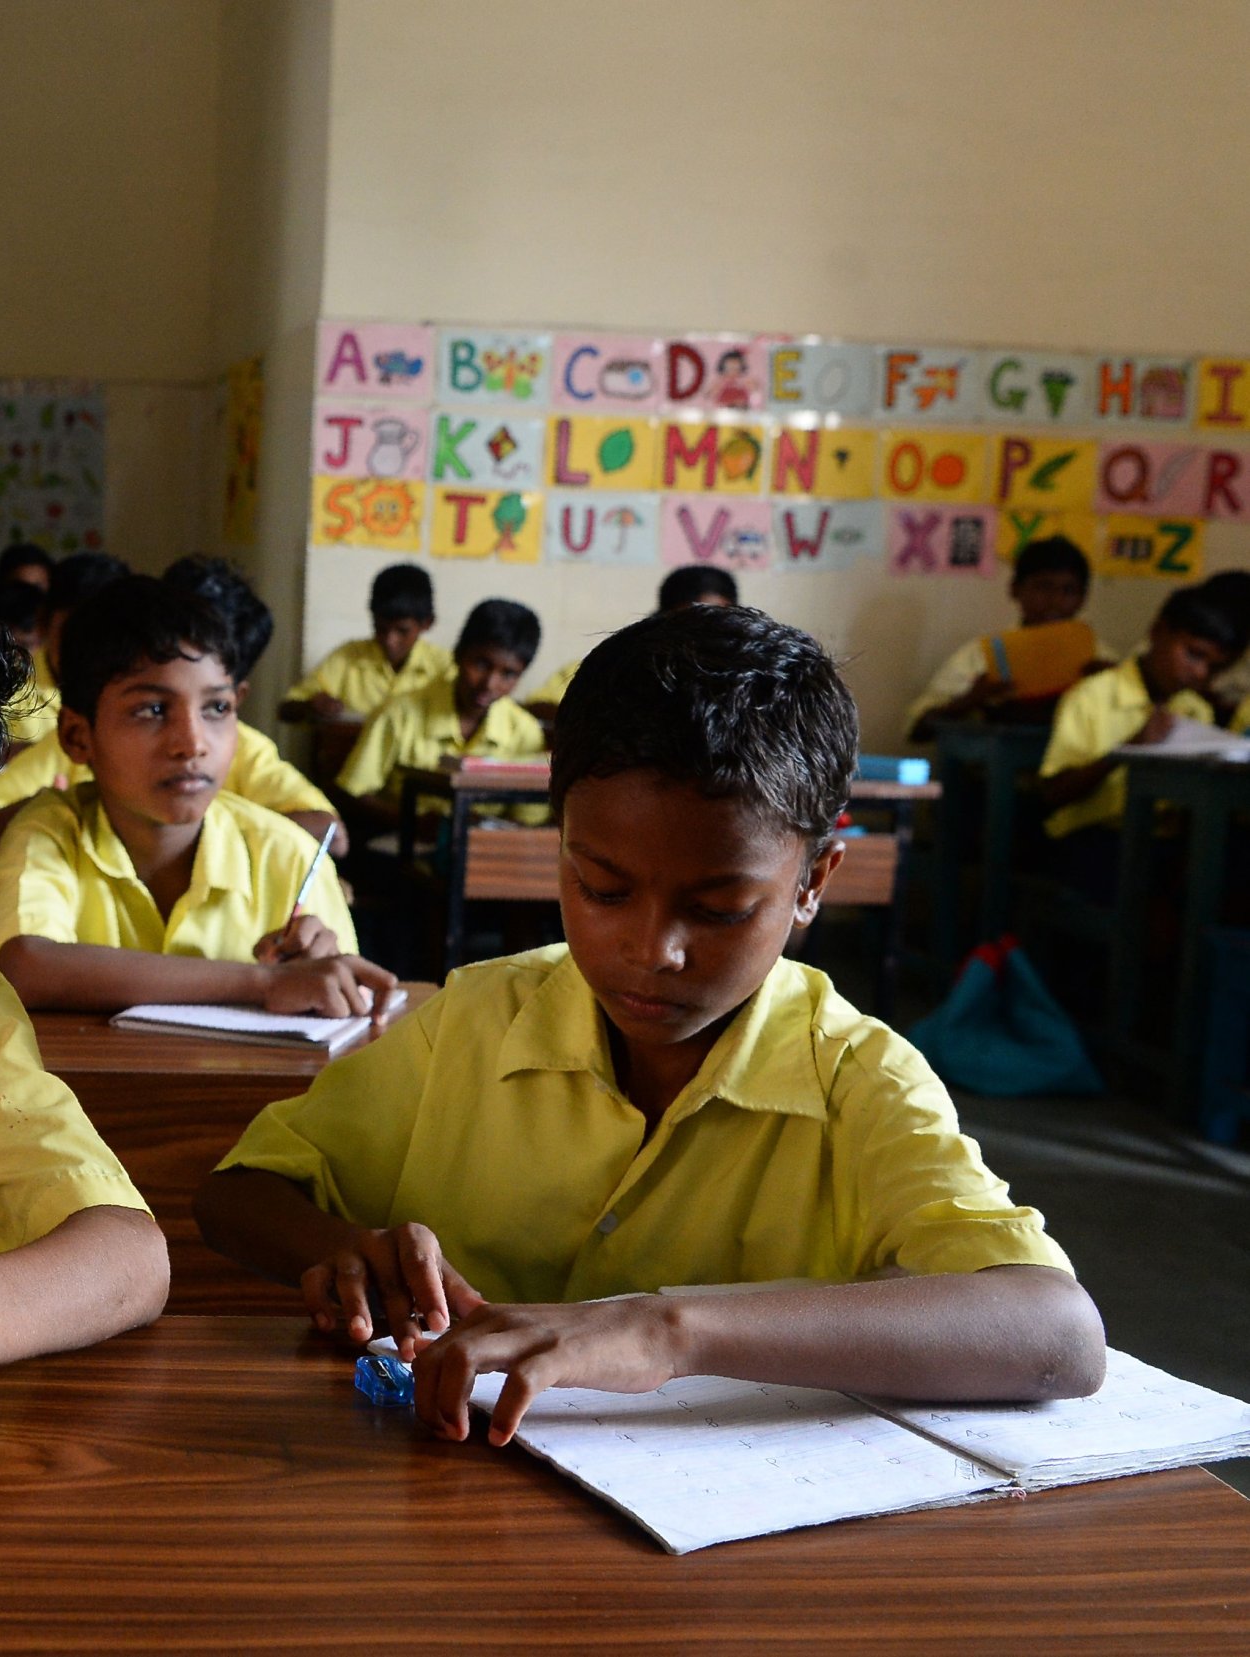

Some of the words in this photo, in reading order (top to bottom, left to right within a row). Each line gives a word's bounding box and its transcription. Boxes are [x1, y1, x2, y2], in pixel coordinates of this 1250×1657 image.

[324, 332, 366, 384] A
[451, 341, 482, 392] B
[566, 346, 599, 400] C
[667, 342, 705, 401] D
[774, 351, 802, 400] E
[884, 354, 920, 409] F
[991, 359, 1027, 412] G
[1098, 362, 1134, 416] H
[1206, 365, 1244, 424] I
[324, 416, 363, 469] J
[434, 416, 478, 480] K
[554, 420, 589, 486] L
[663, 423, 717, 488] M
[773, 429, 820, 493] N
[890, 442, 923, 493] O
[998, 437, 1031, 502] P
[1102, 445, 1151, 502] Q
[1205, 451, 1241, 514] R
[323, 484, 355, 538] S
[445, 493, 487, 545] T
[563, 507, 595, 553] U
[677, 507, 730, 559] V
[783, 508, 830, 558] W
[896, 508, 941, 570] X
[1009, 510, 1042, 557] Y
[1156, 522, 1195, 572] Z
